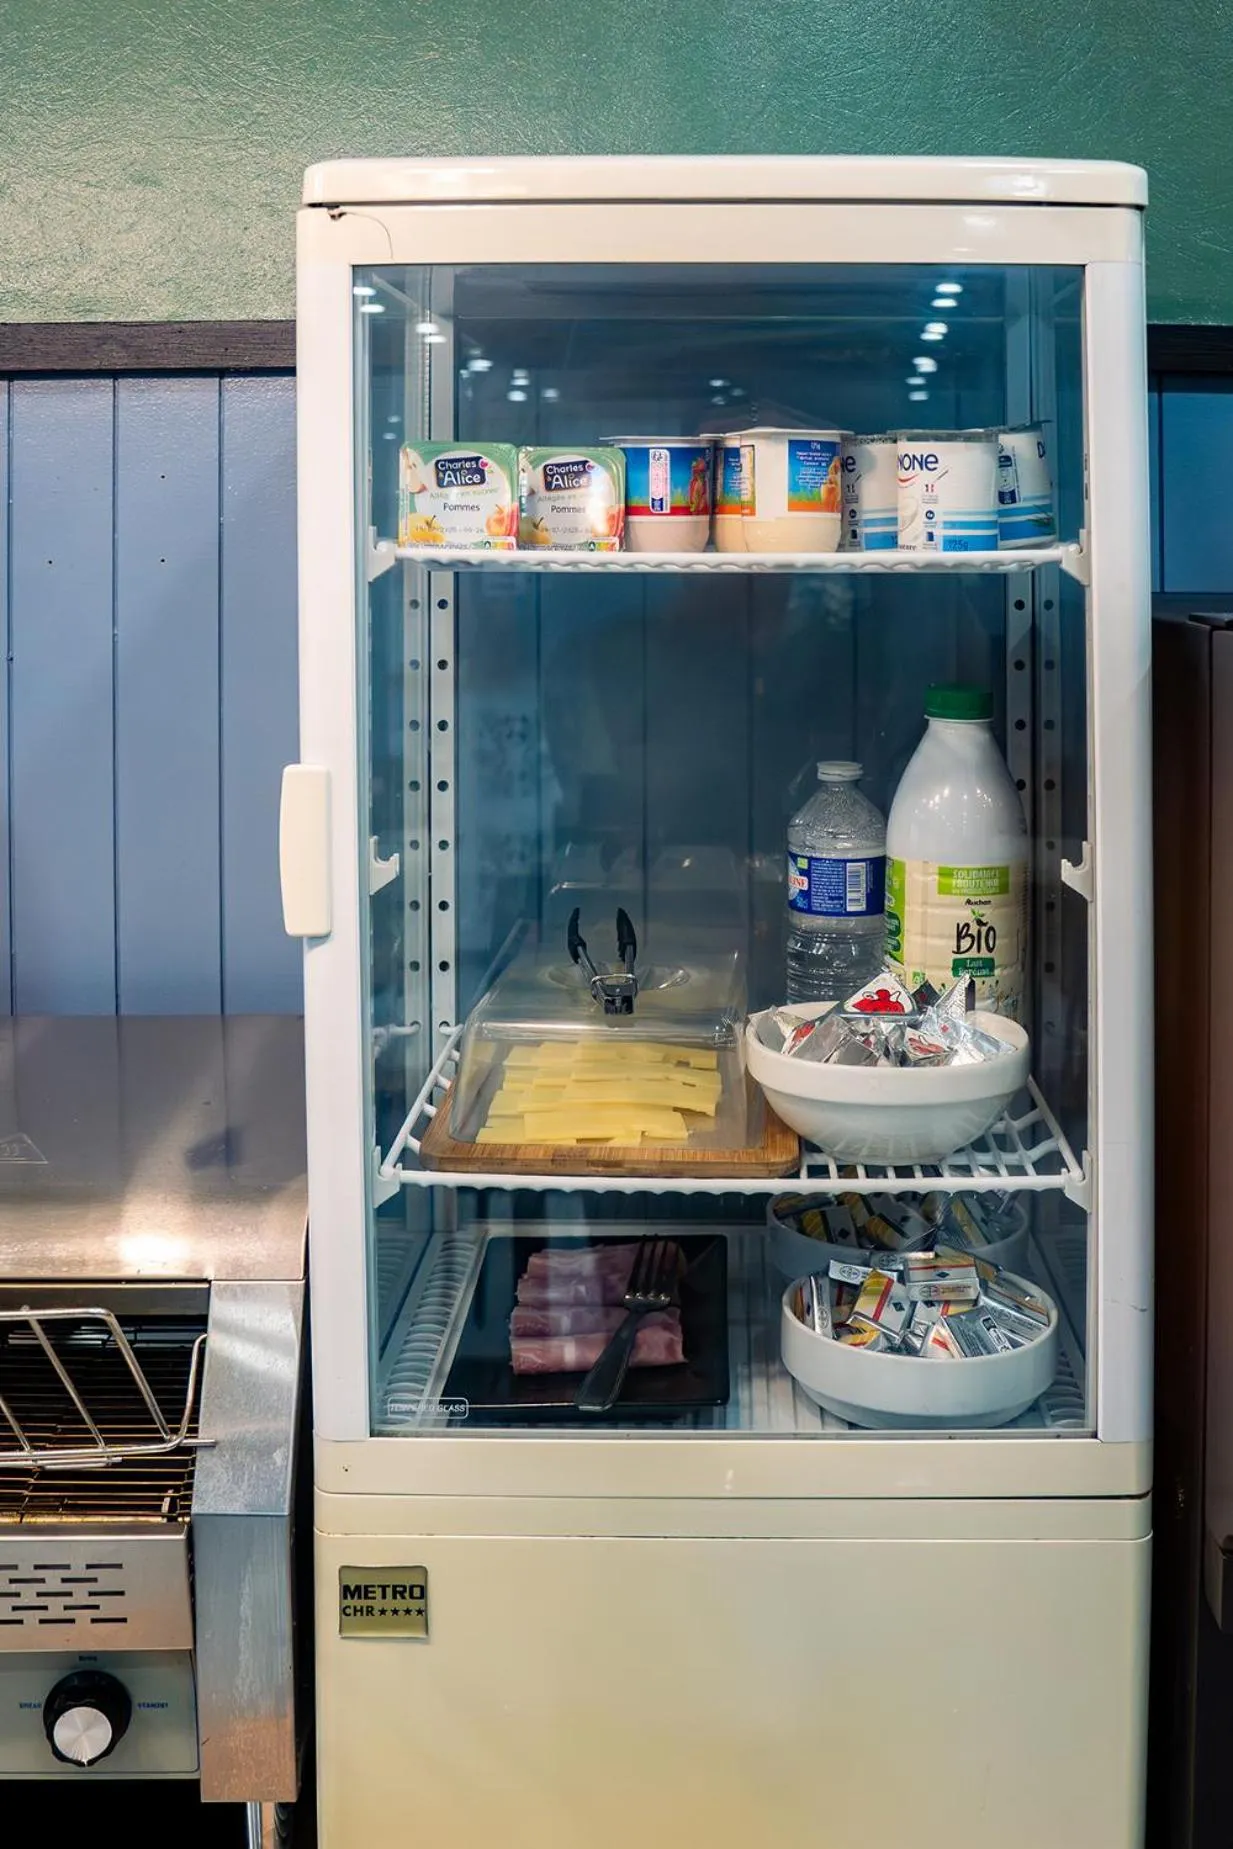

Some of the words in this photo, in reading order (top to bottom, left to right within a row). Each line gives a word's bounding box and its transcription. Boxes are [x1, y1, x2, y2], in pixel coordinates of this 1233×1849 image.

[438, 459, 477, 470] Charles
[546, 464, 584, 474] Charles
[444, 470, 481, 486] Alice
[443, 502, 480, 512] Pommes
[438, 1404, 467, 1413] GLASS
[342, 1584, 425, 1601] METRO
[342, 1605, 375, 1617] CHR
